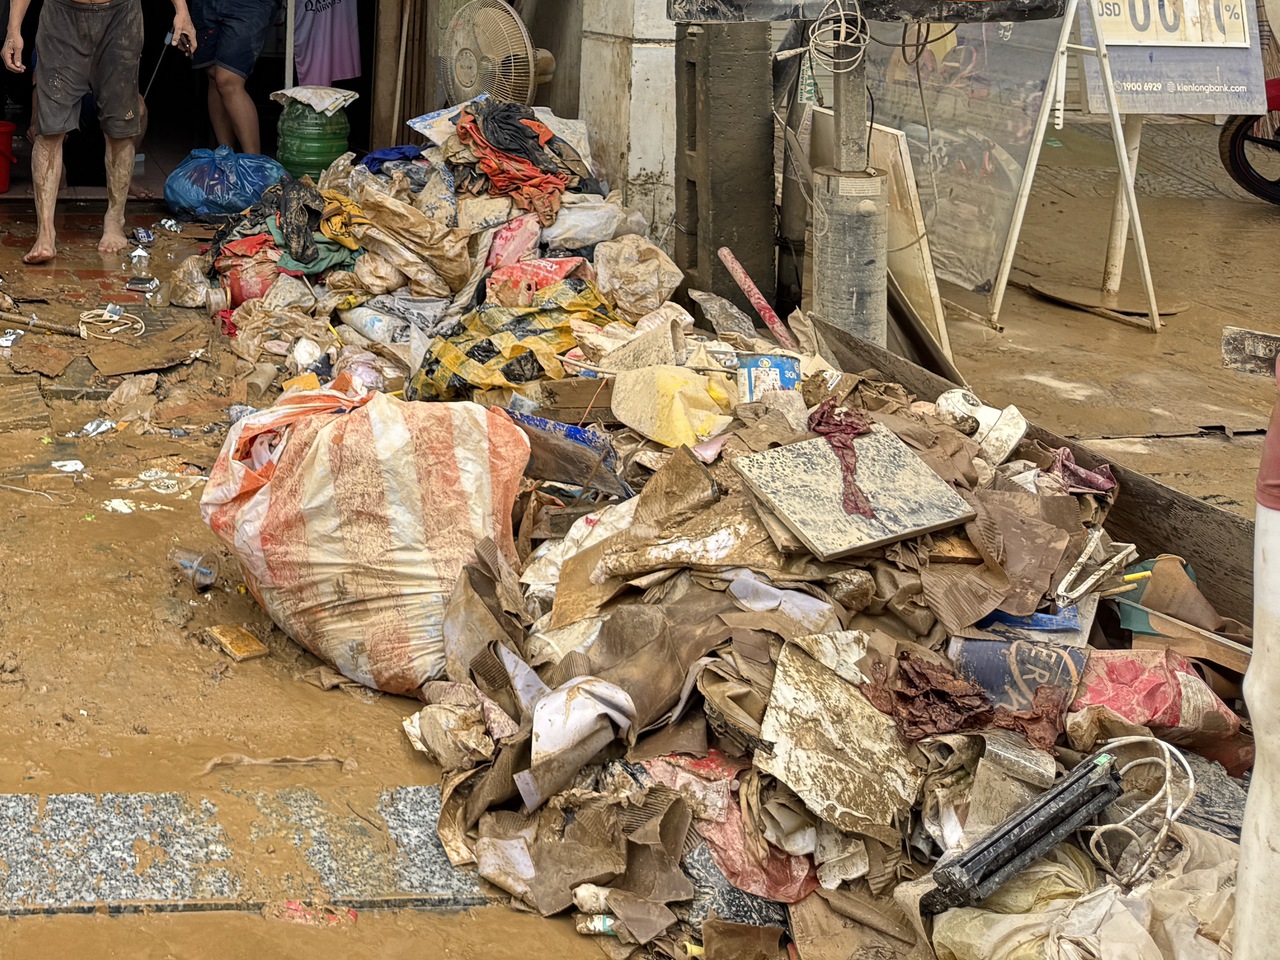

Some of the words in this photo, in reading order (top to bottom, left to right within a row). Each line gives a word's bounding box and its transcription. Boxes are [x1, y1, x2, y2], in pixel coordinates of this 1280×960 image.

[1224, 4, 1241, 20] %
[1123, 82, 1143, 92] 1900
[1144, 82, 1162, 92] 6929
[1176, 82, 1247, 94] kienlongbank.com
